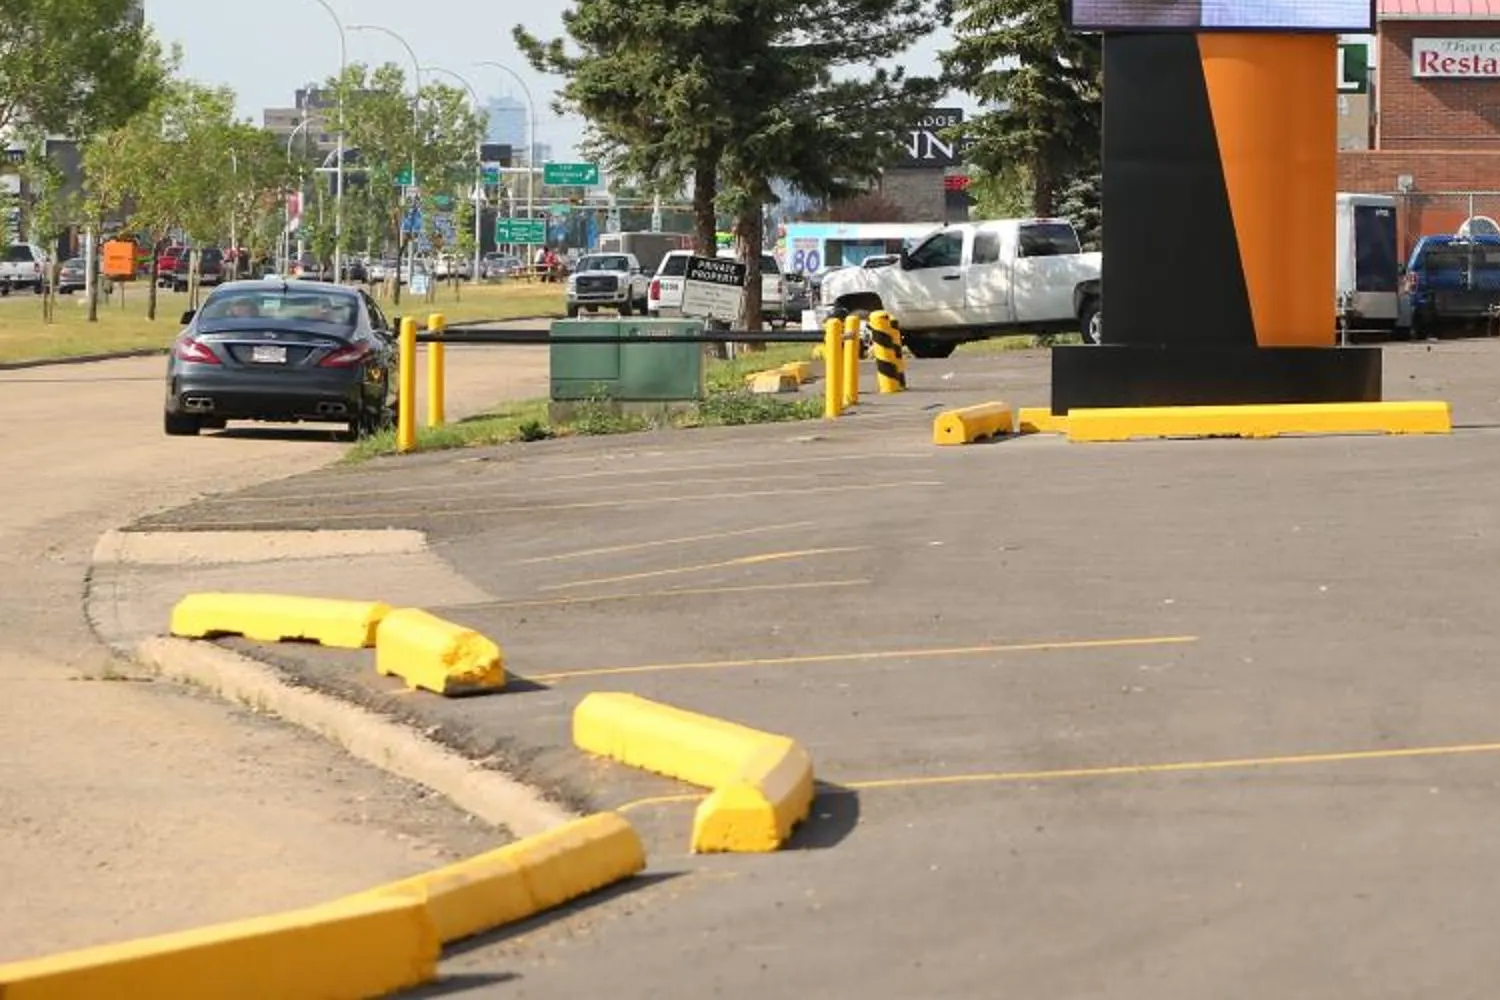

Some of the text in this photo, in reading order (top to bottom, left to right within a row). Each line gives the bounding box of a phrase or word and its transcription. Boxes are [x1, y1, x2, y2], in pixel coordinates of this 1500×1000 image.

[1440, 39, 1483, 53] Thai
[696, 259, 737, 275] PRIVATE
[794, 249, 820, 273] 80
[690, 268, 740, 285] PROPERTY
